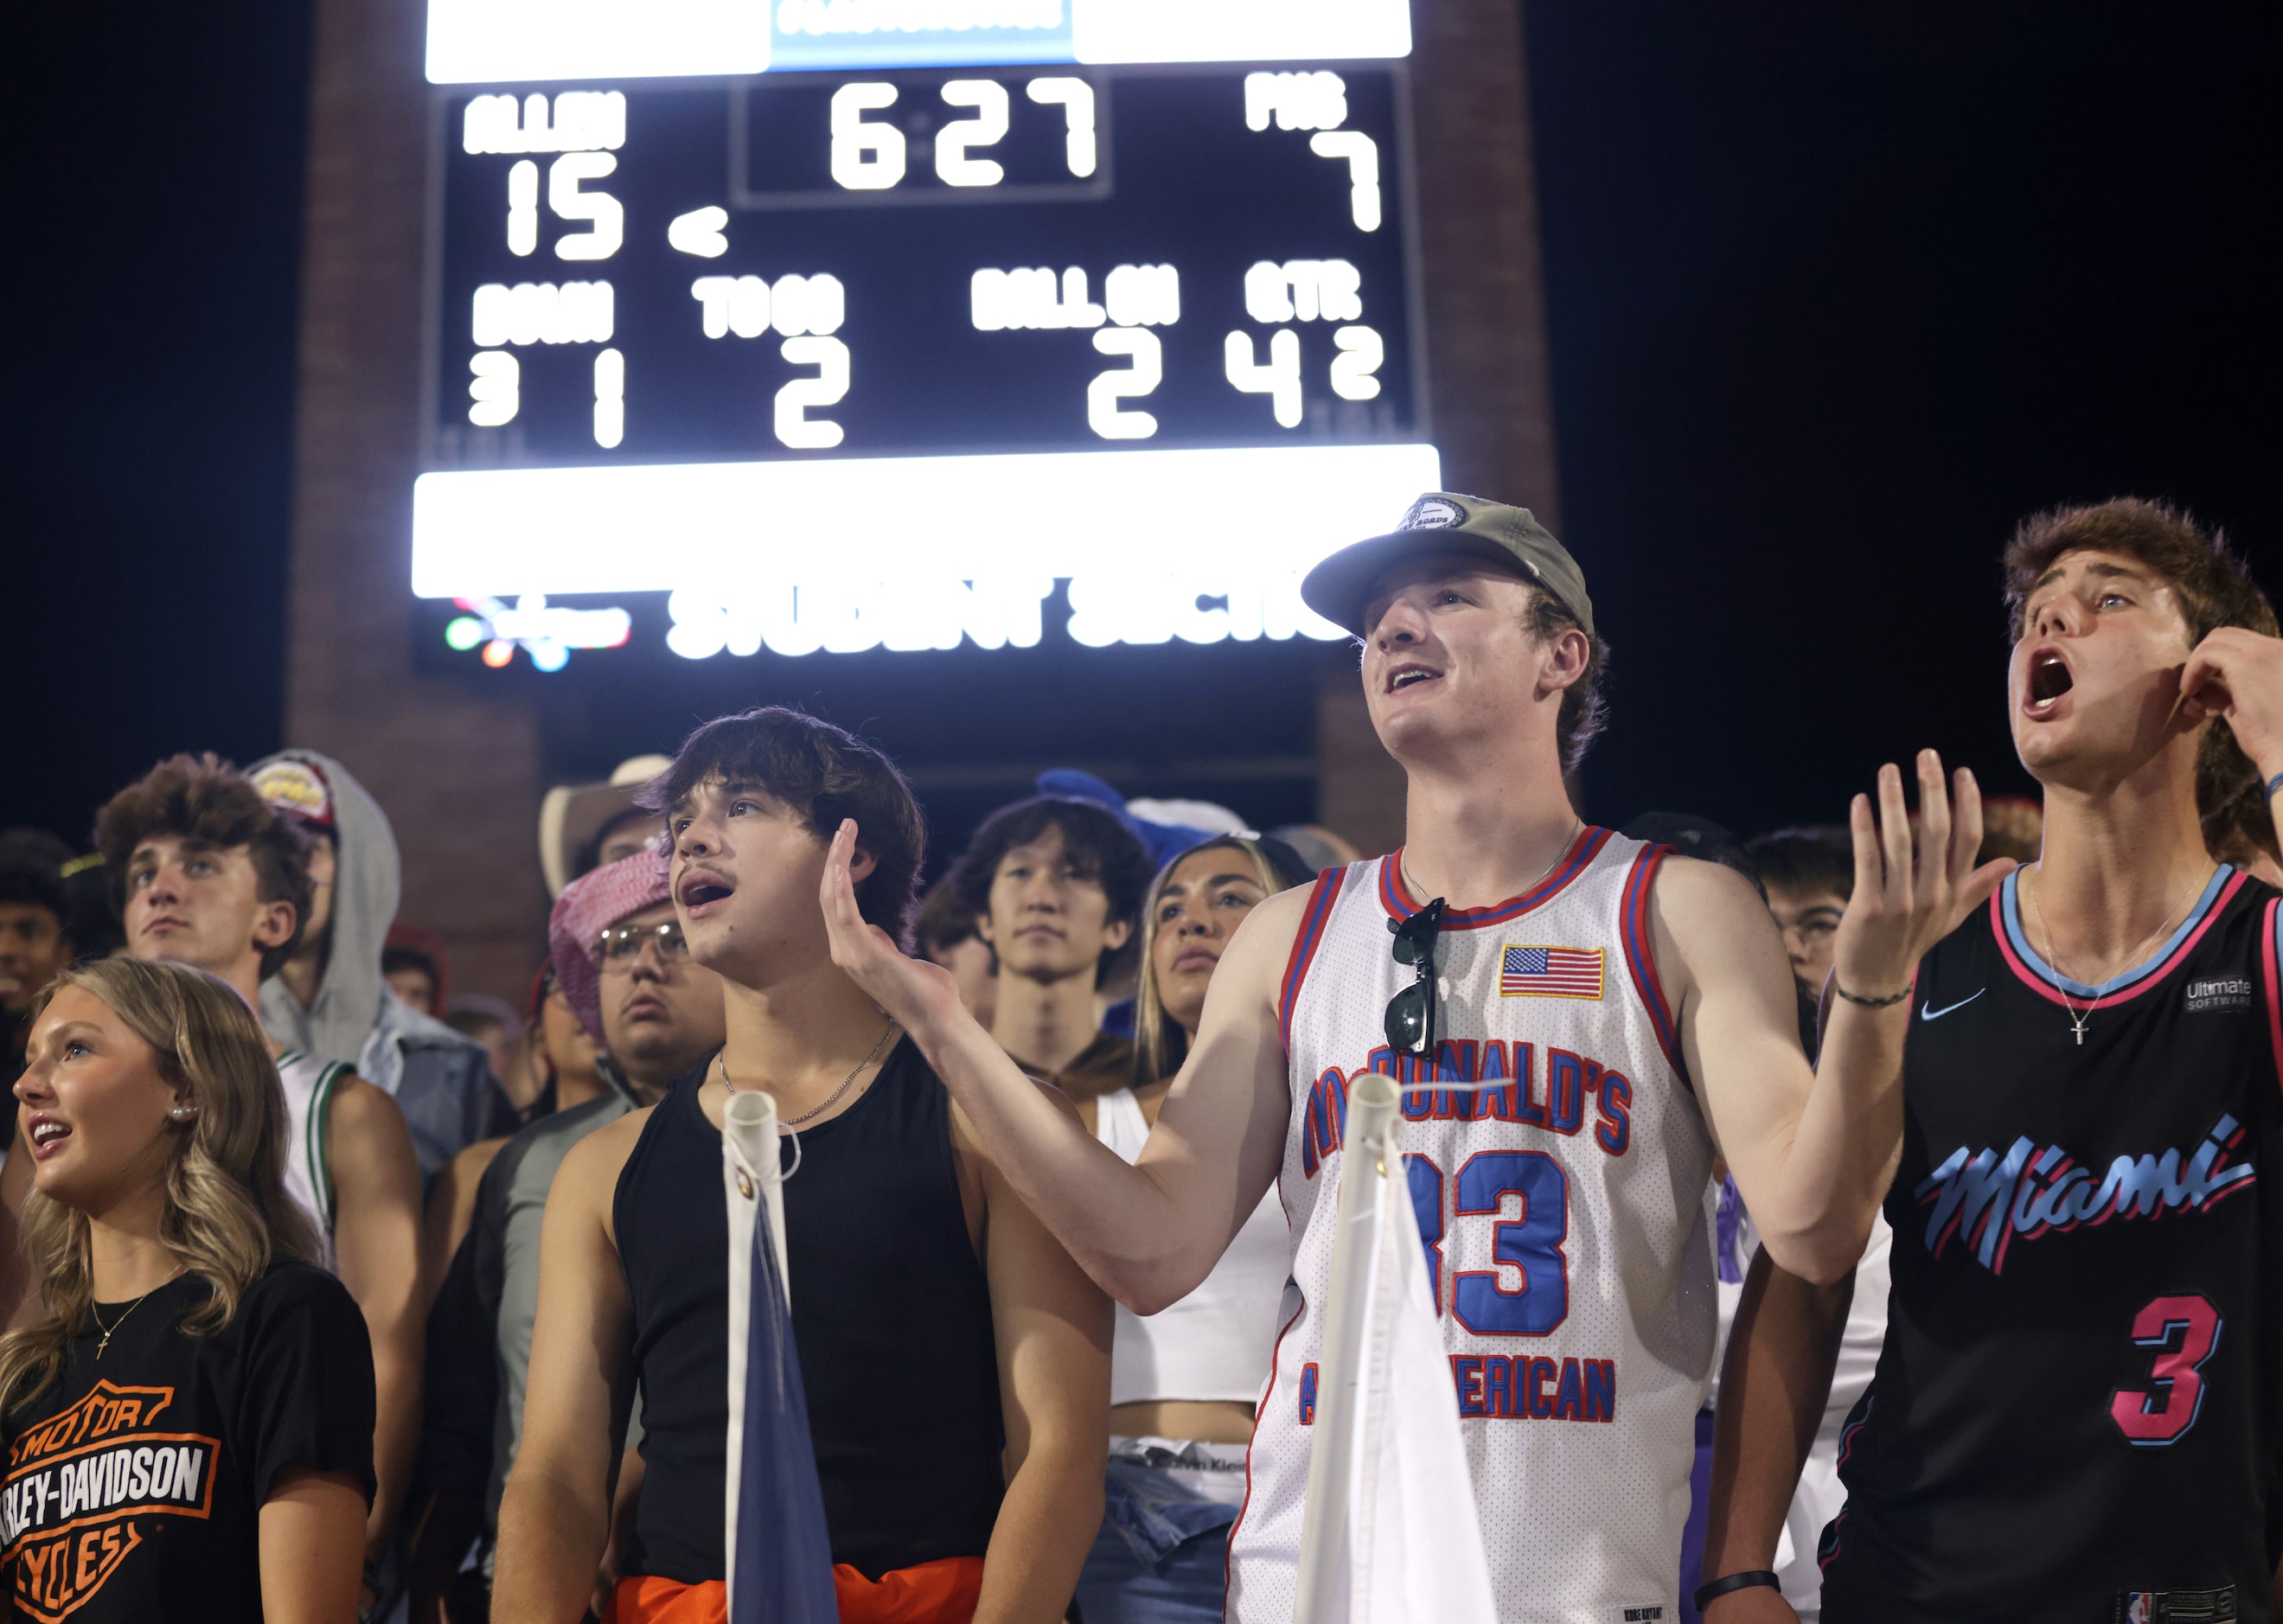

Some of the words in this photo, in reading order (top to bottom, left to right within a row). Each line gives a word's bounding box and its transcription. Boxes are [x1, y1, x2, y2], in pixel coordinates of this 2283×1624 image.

[508, 152, 624, 260] 15
[1309, 131, 1381, 232] 7
[468, 350, 519, 426] 3
[594, 348, 624, 449] 1
[774, 336, 850, 449] 2
[1088, 327, 1162, 439] 2
[1225, 329, 1302, 428] 4
[1330, 325, 1384, 400] 2
[2187, 979, 2251, 998] Ultimate
[2188, 996, 2252, 1010] SOFTWARE
[1302, 1039, 1633, 1180] MONALD'S
[1914, 1113, 2255, 1276] Miami
[2111, 1295, 2223, 1446] 3
[22, 1393, 142, 1459] MOTOR
[0, 1447, 203, 1547] ARLEY-DAVIDSON
